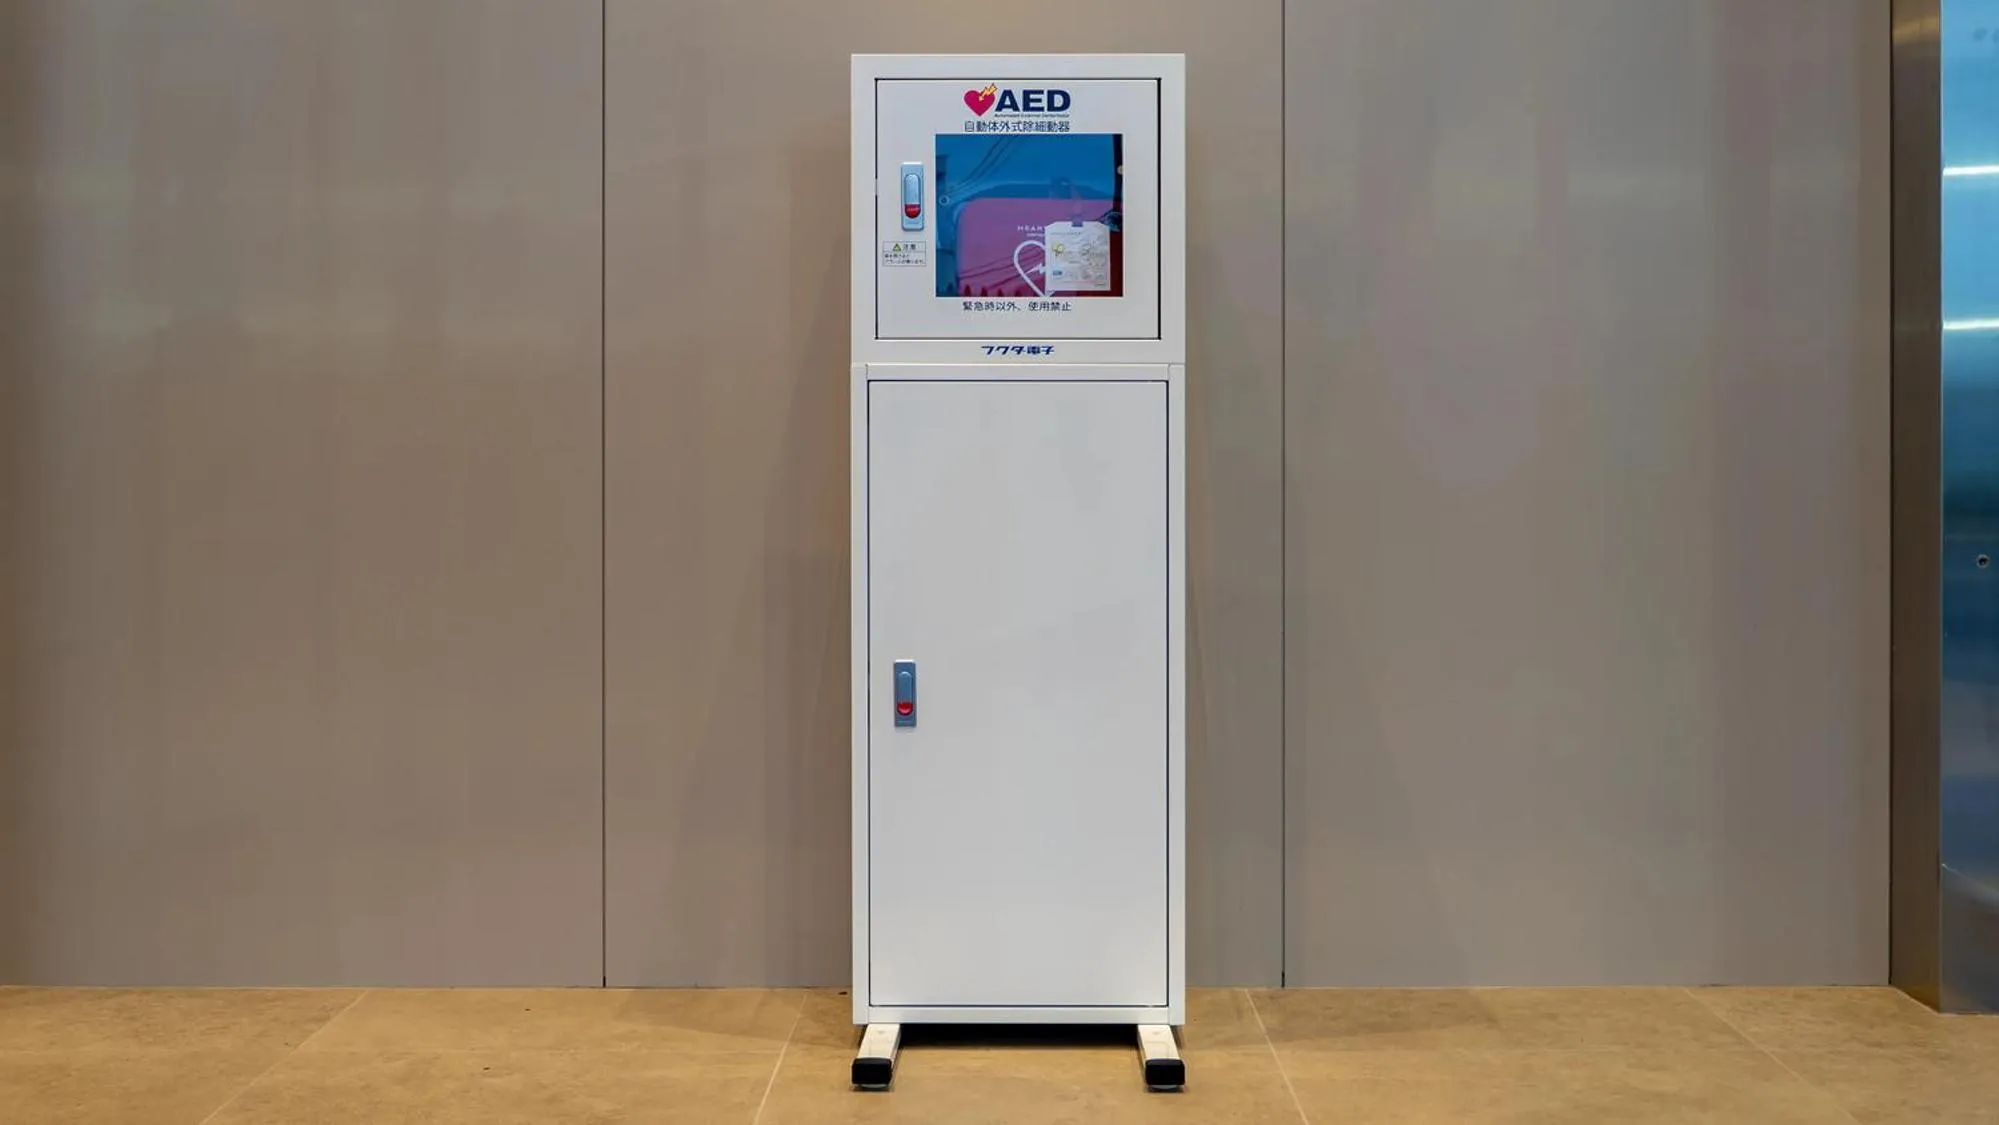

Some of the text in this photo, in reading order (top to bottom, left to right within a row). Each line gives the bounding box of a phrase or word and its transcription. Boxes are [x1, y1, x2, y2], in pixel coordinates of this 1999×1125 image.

[995, 89, 1071, 112] AED
[964, 120, 1070, 132] 自動体外式除細動器
[962, 301, 1072, 311] 緊急時以外、使用禁止
